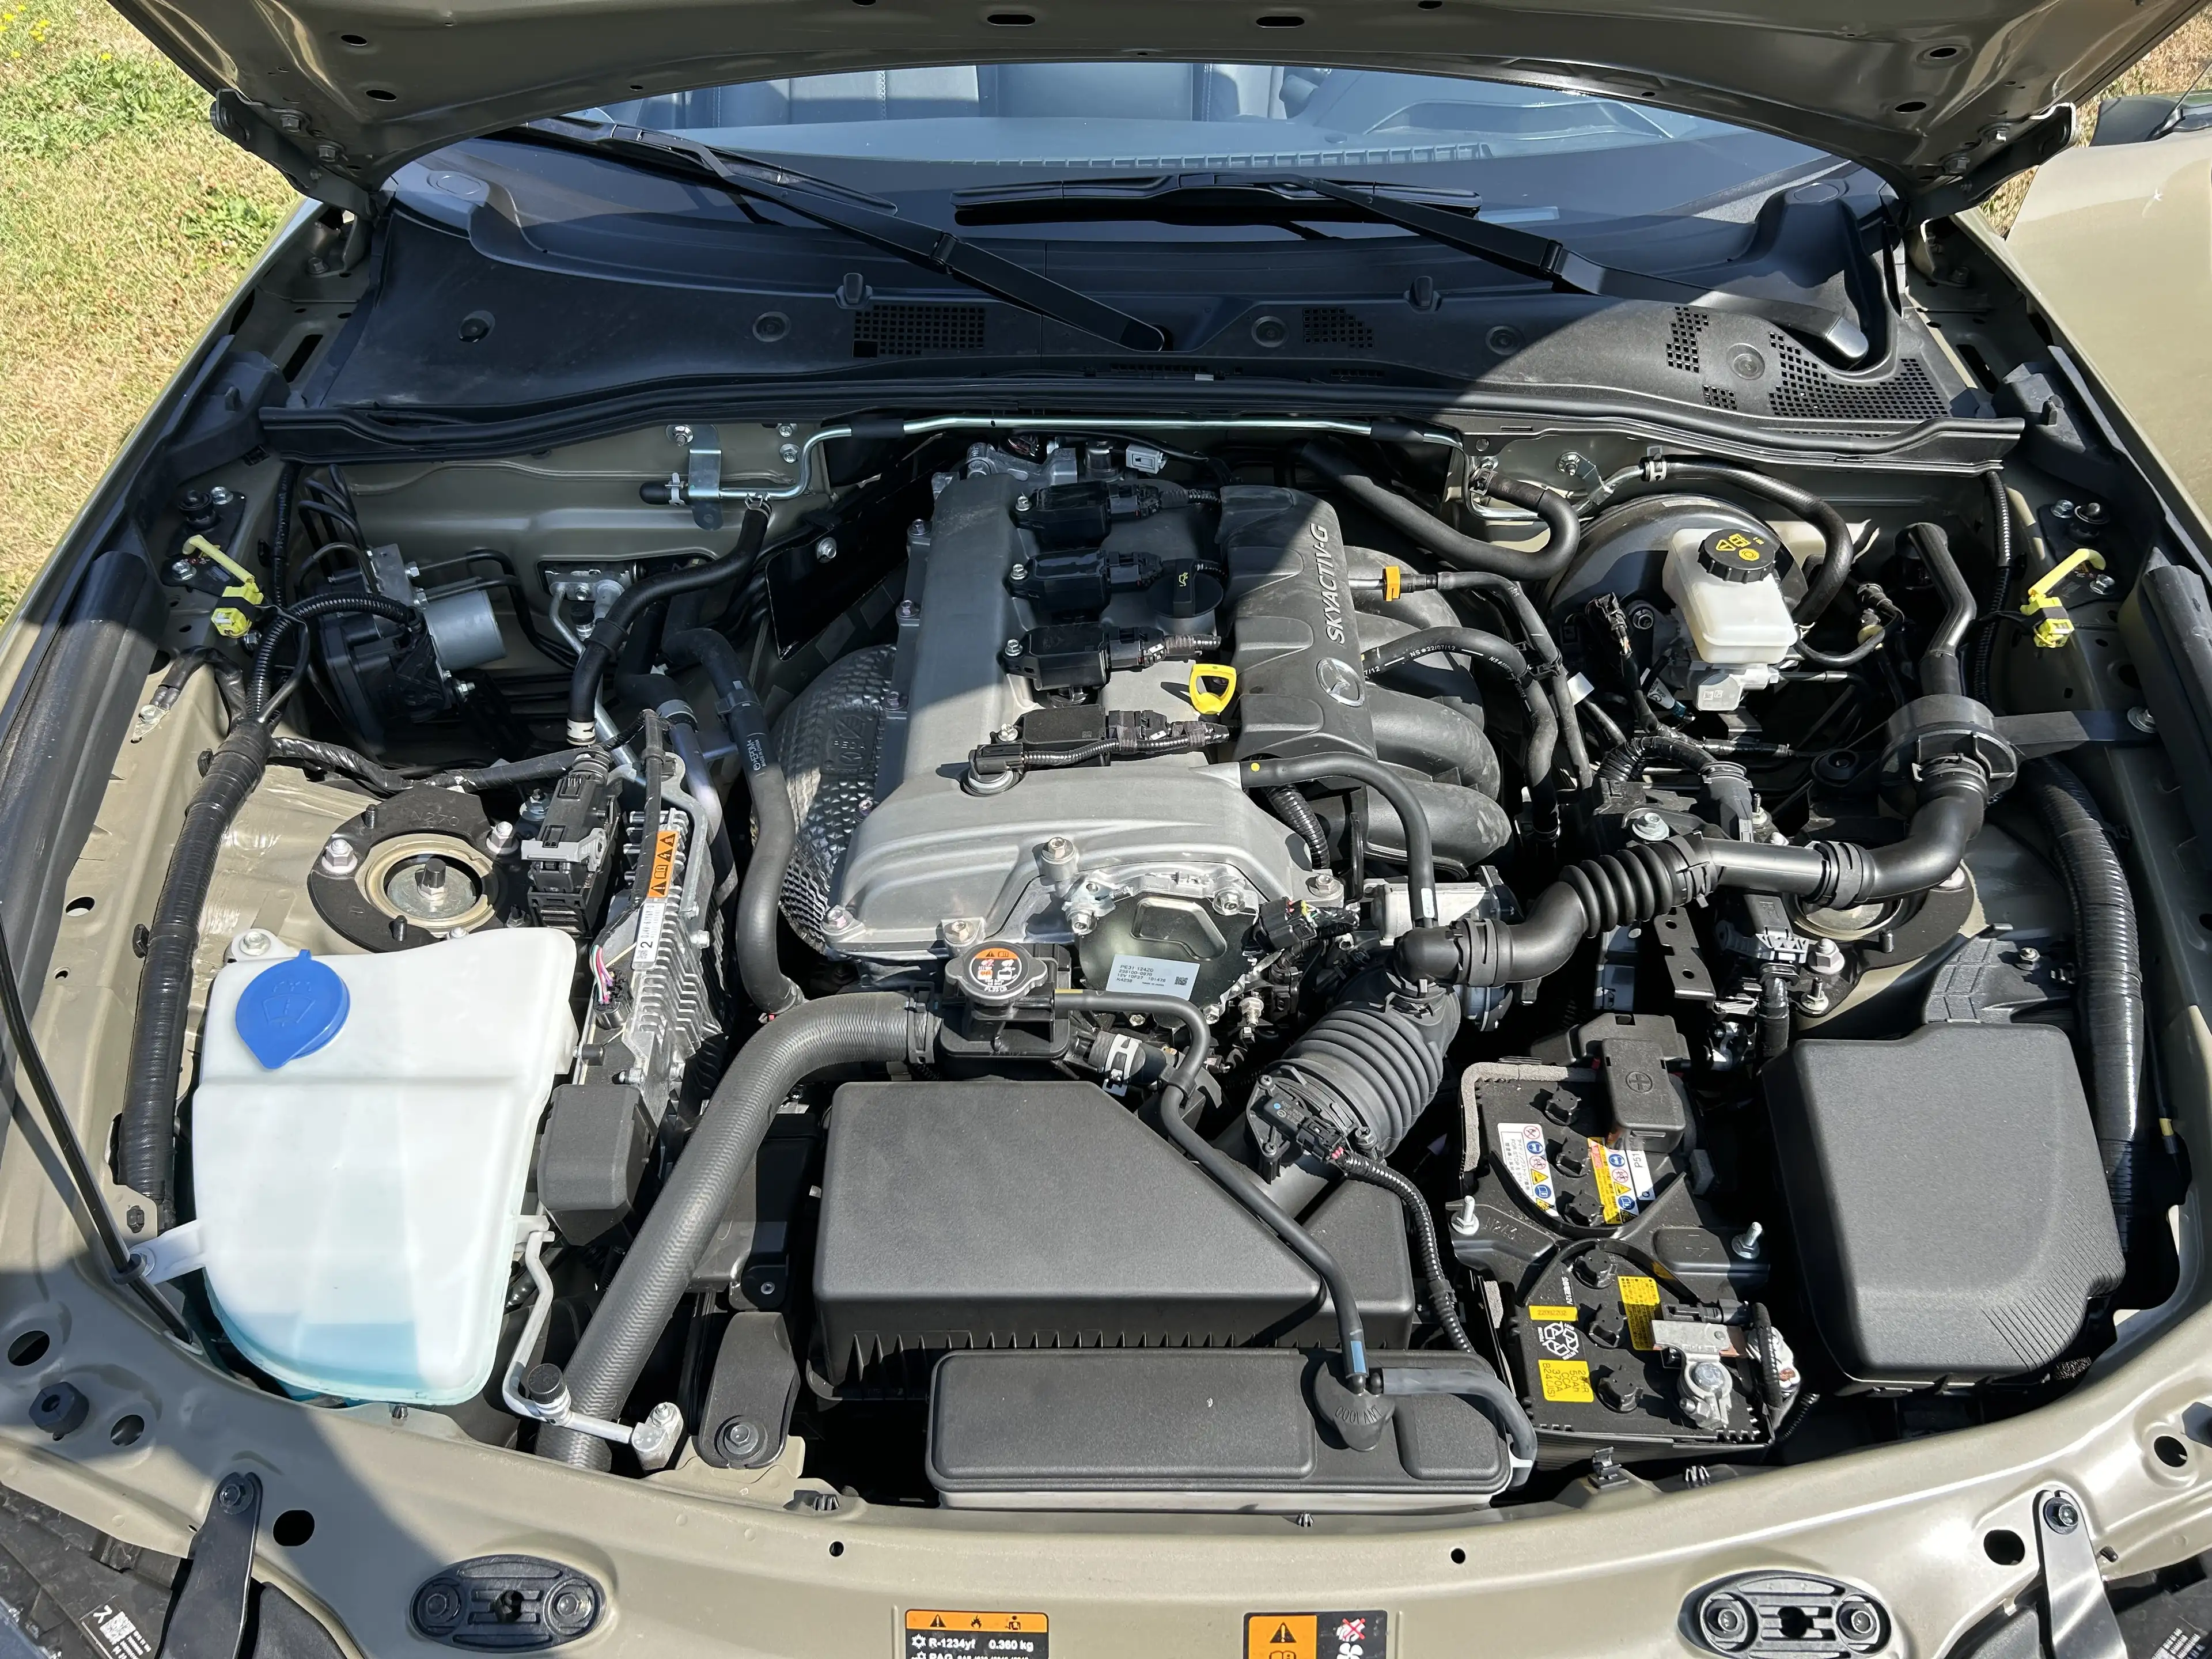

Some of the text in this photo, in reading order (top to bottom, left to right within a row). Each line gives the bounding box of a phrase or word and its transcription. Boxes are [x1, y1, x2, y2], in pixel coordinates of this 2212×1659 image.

[1310, 523, 1345, 645] SKYACTIV-G
[1542, 1363, 1555, 1397] B24(JIS)
[1552, 1370, 1563, 1392] 370A
[1562, 1372, 1571, 1389] CCA
[1570, 1370, 1580, 1392] 50Ah
[929, 1637, 976, 1651] R-1234yf
[1020, 1639, 1034, 1652] kg
